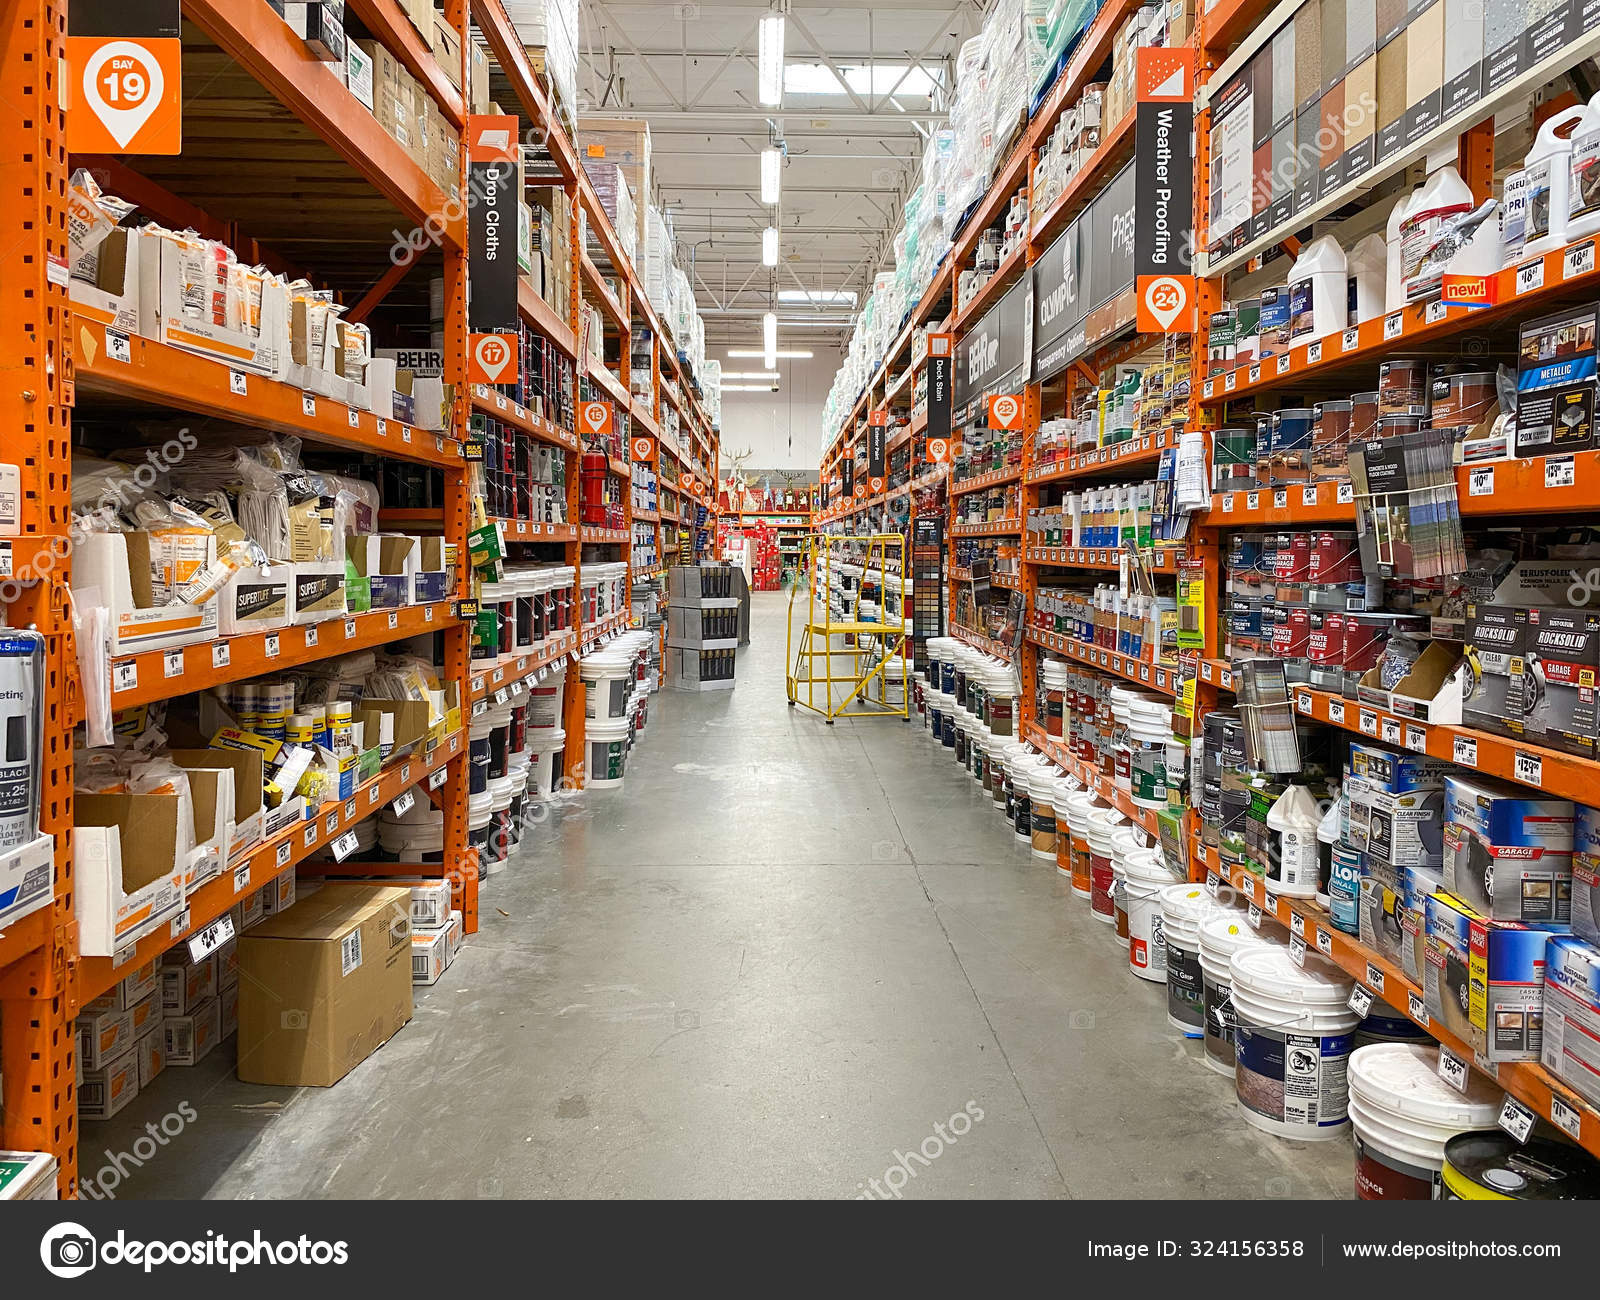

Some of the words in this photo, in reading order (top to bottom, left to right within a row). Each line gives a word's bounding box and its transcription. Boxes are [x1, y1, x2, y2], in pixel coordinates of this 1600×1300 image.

[112, 60, 134, 69] BAY
[103, 72, 146, 102] 19
[1157, 108, 1173, 184] Weather
[485, 168, 500, 206] Drop
[1509, 198, 1525, 212] PRI
[68, 198, 99, 229] HDX
[1151, 189, 1172, 264] Proofing
[485, 210, 500, 261] Cloths
[1448, 280, 1486, 298] new!
[1041, 273, 1077, 326] OLYMPIC
[1156, 292, 1178, 307] 24
[484, 349, 500, 363] 17
[968, 332, 988, 385] BEHR
[1036, 345, 1066, 373] Transparency
[1066, 330, 1086, 358] Options
[396, 352, 441, 368] BEHR
[1540, 364, 1572, 380] METALLIC
[998, 405, 1014, 414] 22
[1520, 432, 1533, 442] 20X
[300, 578, 328, 597] SUPERTUFF
[238, 588, 270, 606] SUPERTUFF
[1550, 620, 1574, 628] RUST-OLEUM
[1474, 626, 1516, 642] ROCKSOLID
[1538, 631, 1586, 648] ROCKSOLID
[1485, 652, 1502, 662] CLEAR
[1547, 663, 1571, 676] GARAGE
[1581, 671, 1592, 680] 20X
[221, 729, 241, 740] 3M
[12, 784, 25, 796] 25
[1574, 868, 1594, 882] GARAGE
[1471, 928, 1486, 940] VALUE
[1471, 936, 1486, 949] PACK!
[1425, 949, 1444, 964] GARAGE
[1180, 971, 1194, 980] GRIP
[1564, 965, 1588, 984] RUST-OLEUM
